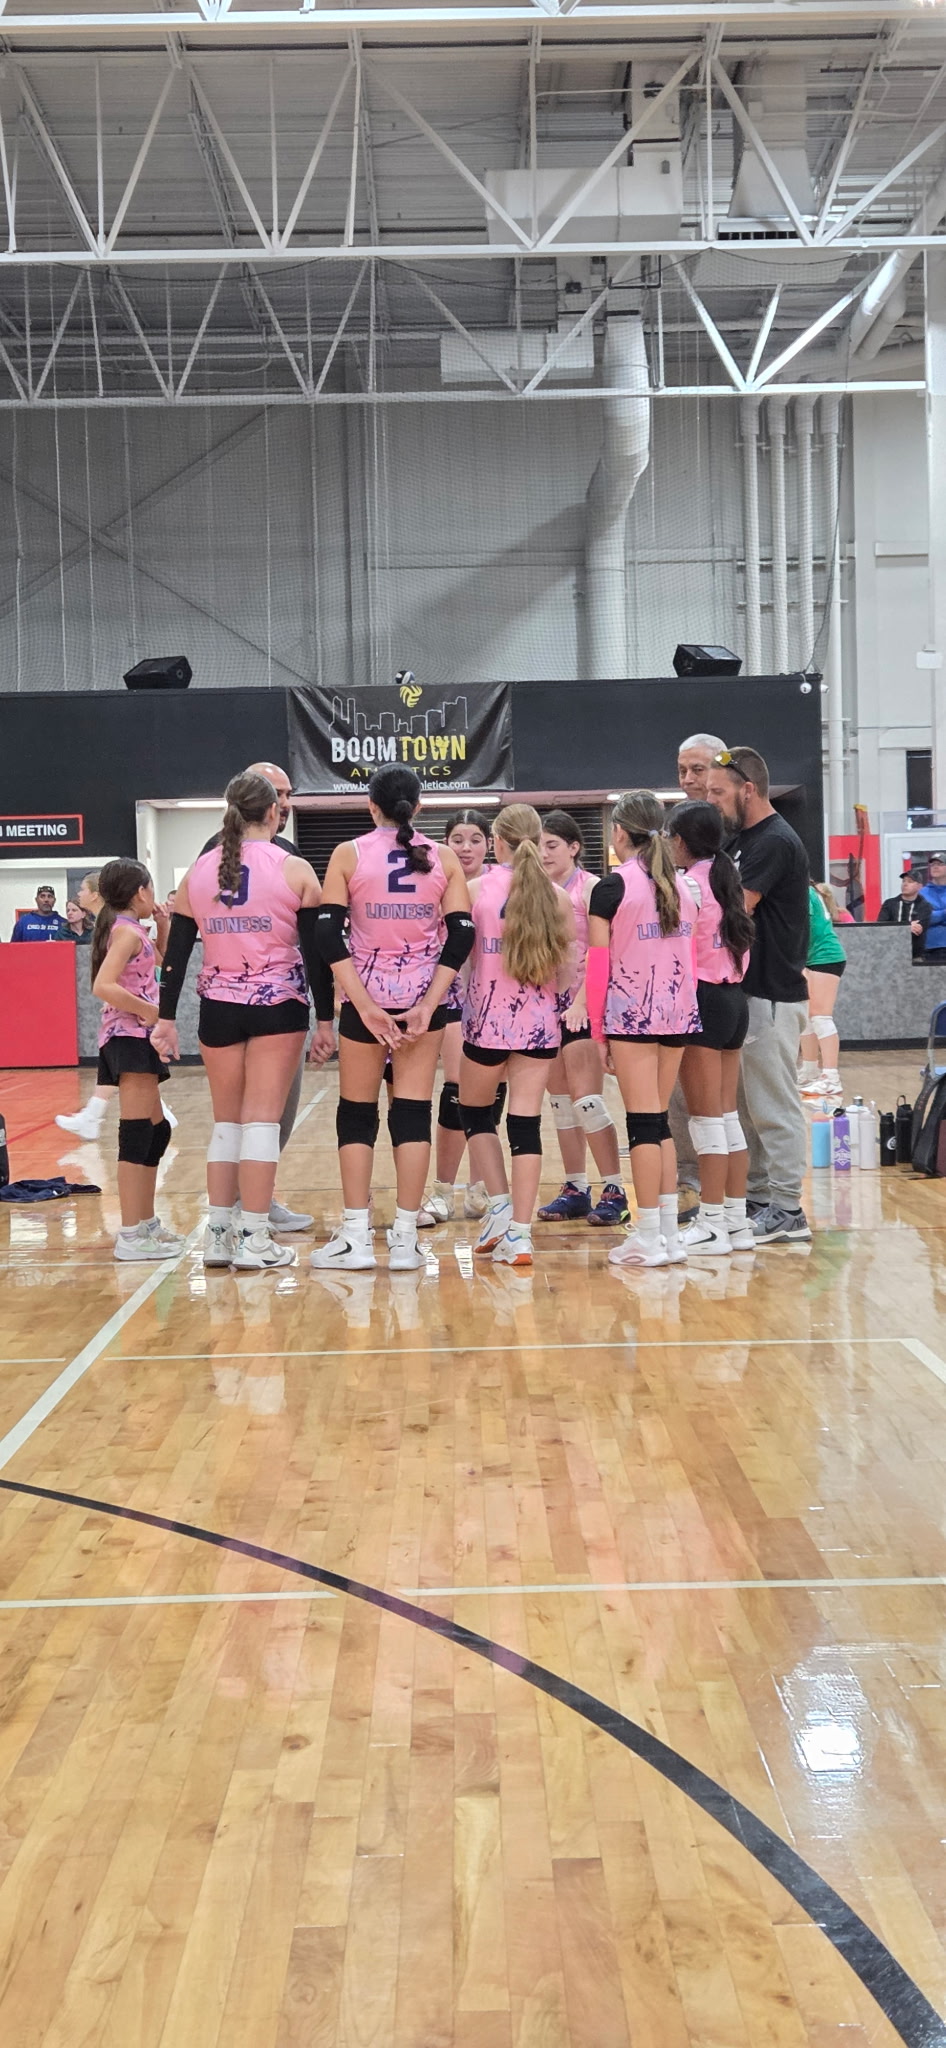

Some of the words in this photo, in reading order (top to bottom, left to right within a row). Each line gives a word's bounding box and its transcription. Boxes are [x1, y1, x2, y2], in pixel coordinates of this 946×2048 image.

[331, 735, 466, 763] BOOMTOWN
[350, 765, 452, 777] ATTICS
[6, 824, 67, 836] MEETING
[387, 850, 416, 893] 2
[366, 903, 434, 919] LIONESS
[203, 916, 272, 934] LIONESS
